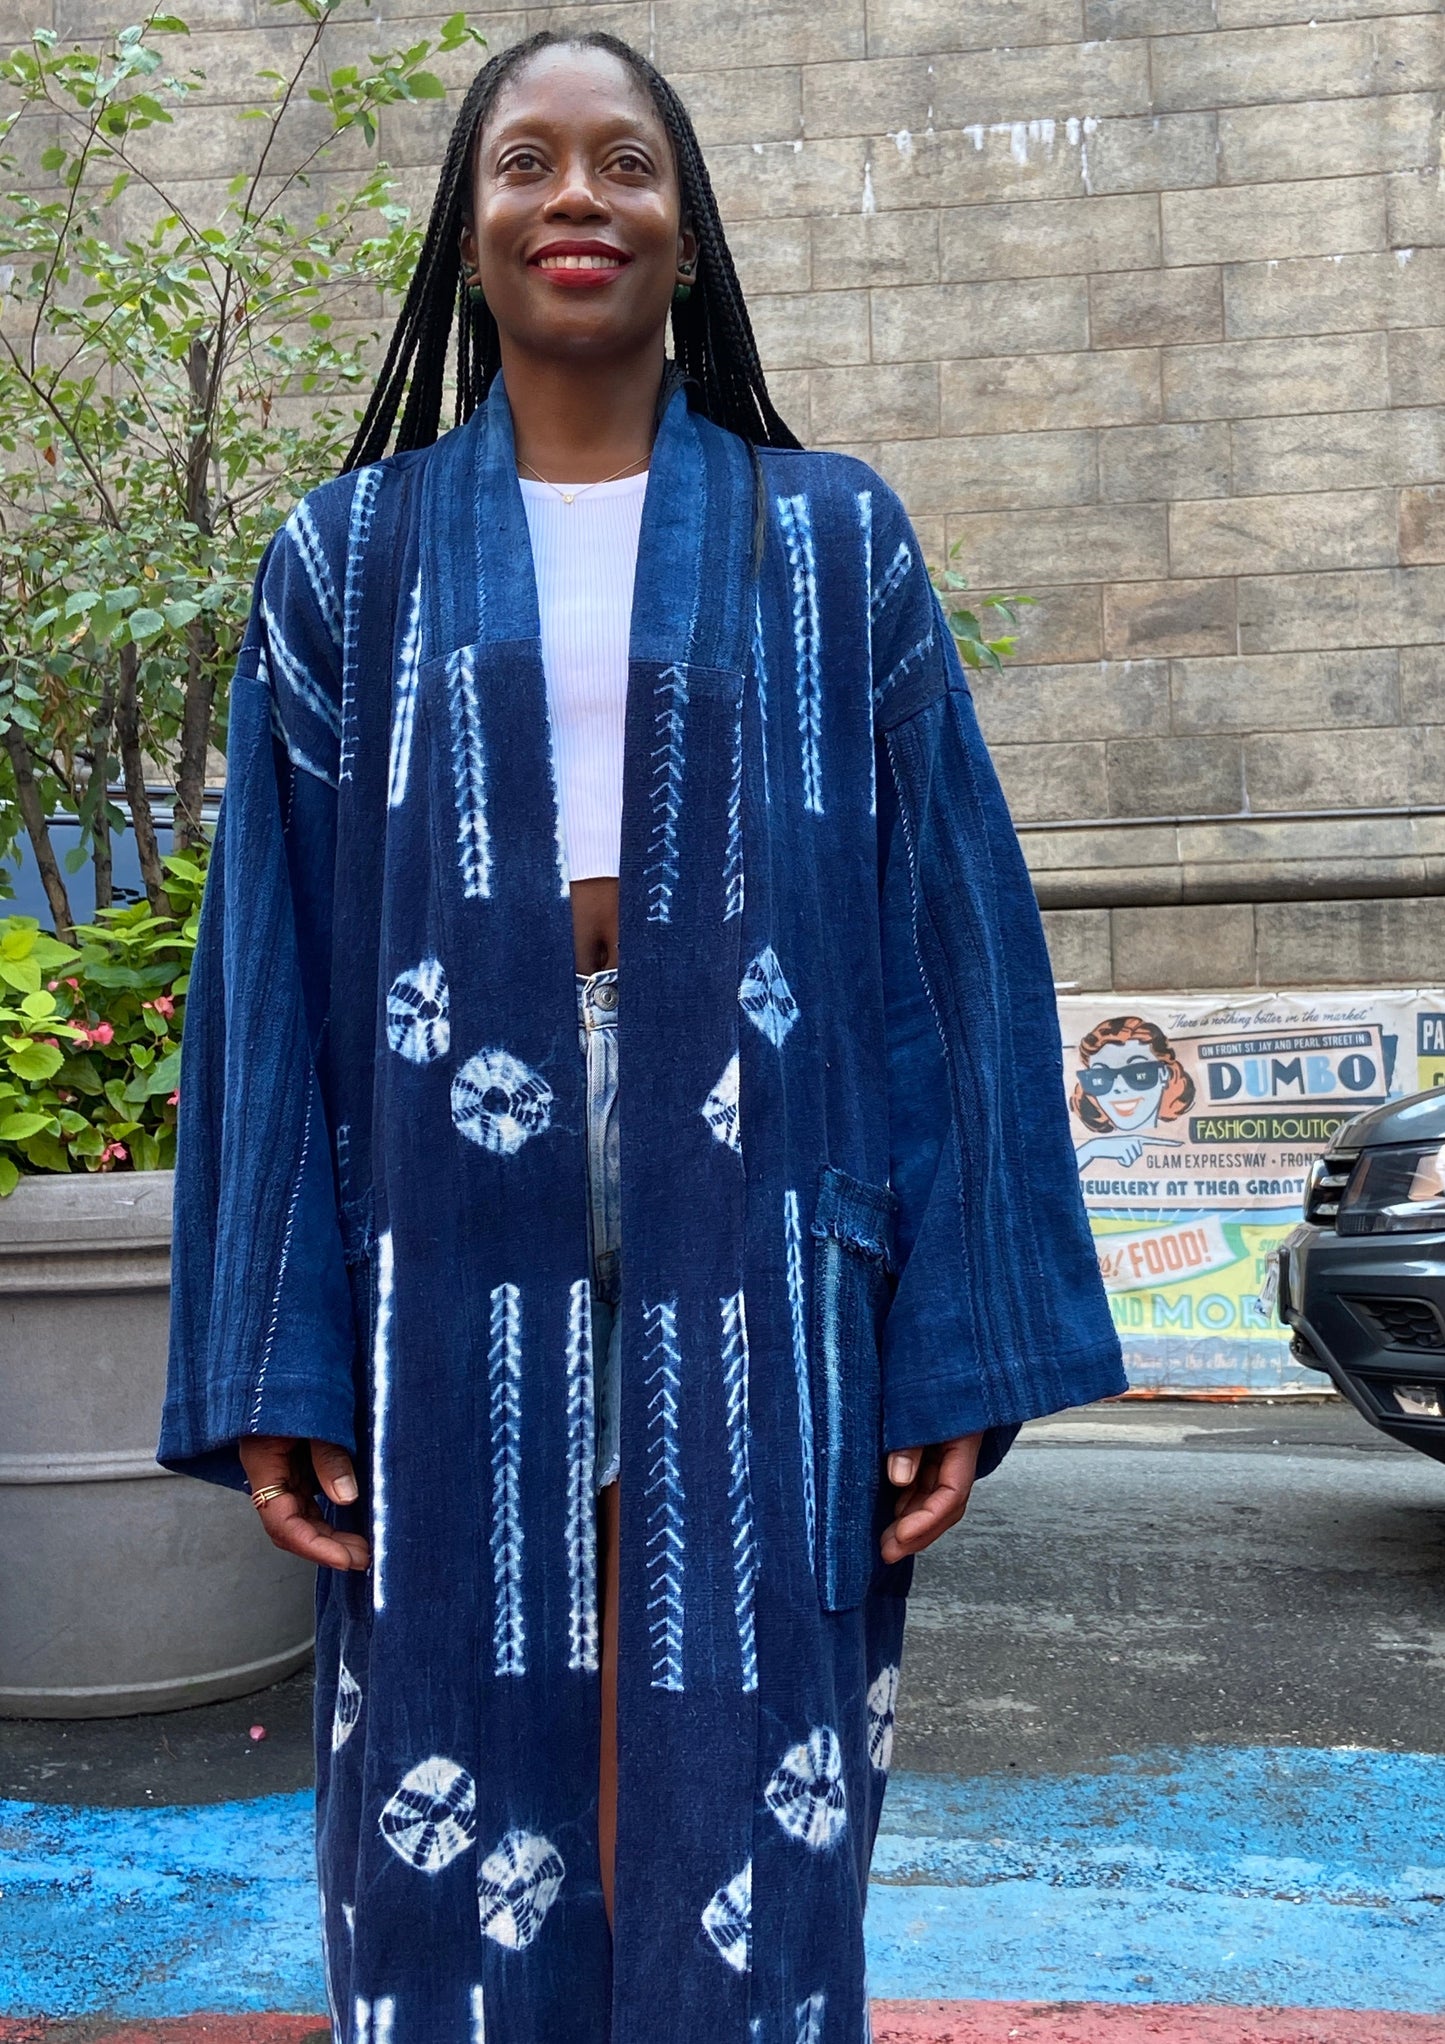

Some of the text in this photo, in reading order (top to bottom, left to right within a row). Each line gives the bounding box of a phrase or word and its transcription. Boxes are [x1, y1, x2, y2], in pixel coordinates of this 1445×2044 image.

[1200, 1017, 1209, 1026] is
[1211, 1011, 1251, 1029] nothing
[1254, 1010, 1281, 1024] better
[1302, 1008, 1320, 1022] the
[1201, 1046, 1214, 1057] ON
[1216, 1043, 1242, 1056] FRONT
[1258, 1041, 1273, 1051] JAY
[1274, 1039, 1292, 1050] AND
[1294, 1037, 1321, 1048] PEARL
[1322, 1034, 1353, 1047] STREET
[1355, 1034, 1365, 1044] IN
[1208, 1053, 1377, 1100] DUMBO
[1196, 1118, 1345, 1140] FASHION BOUTIQ
[1146, 1153, 1184, 1169] GLAM
[1186, 1151, 1266, 1168] EXPRESSWAY
[1166, 1181, 1188, 1195] AT
[1194, 1180, 1240, 1195] THEA
[1246, 1179, 1304, 1195] GRANT
[1127, 1228, 1212, 1278] FOOD!
[1151, 1293, 1292, 1329] MOR
